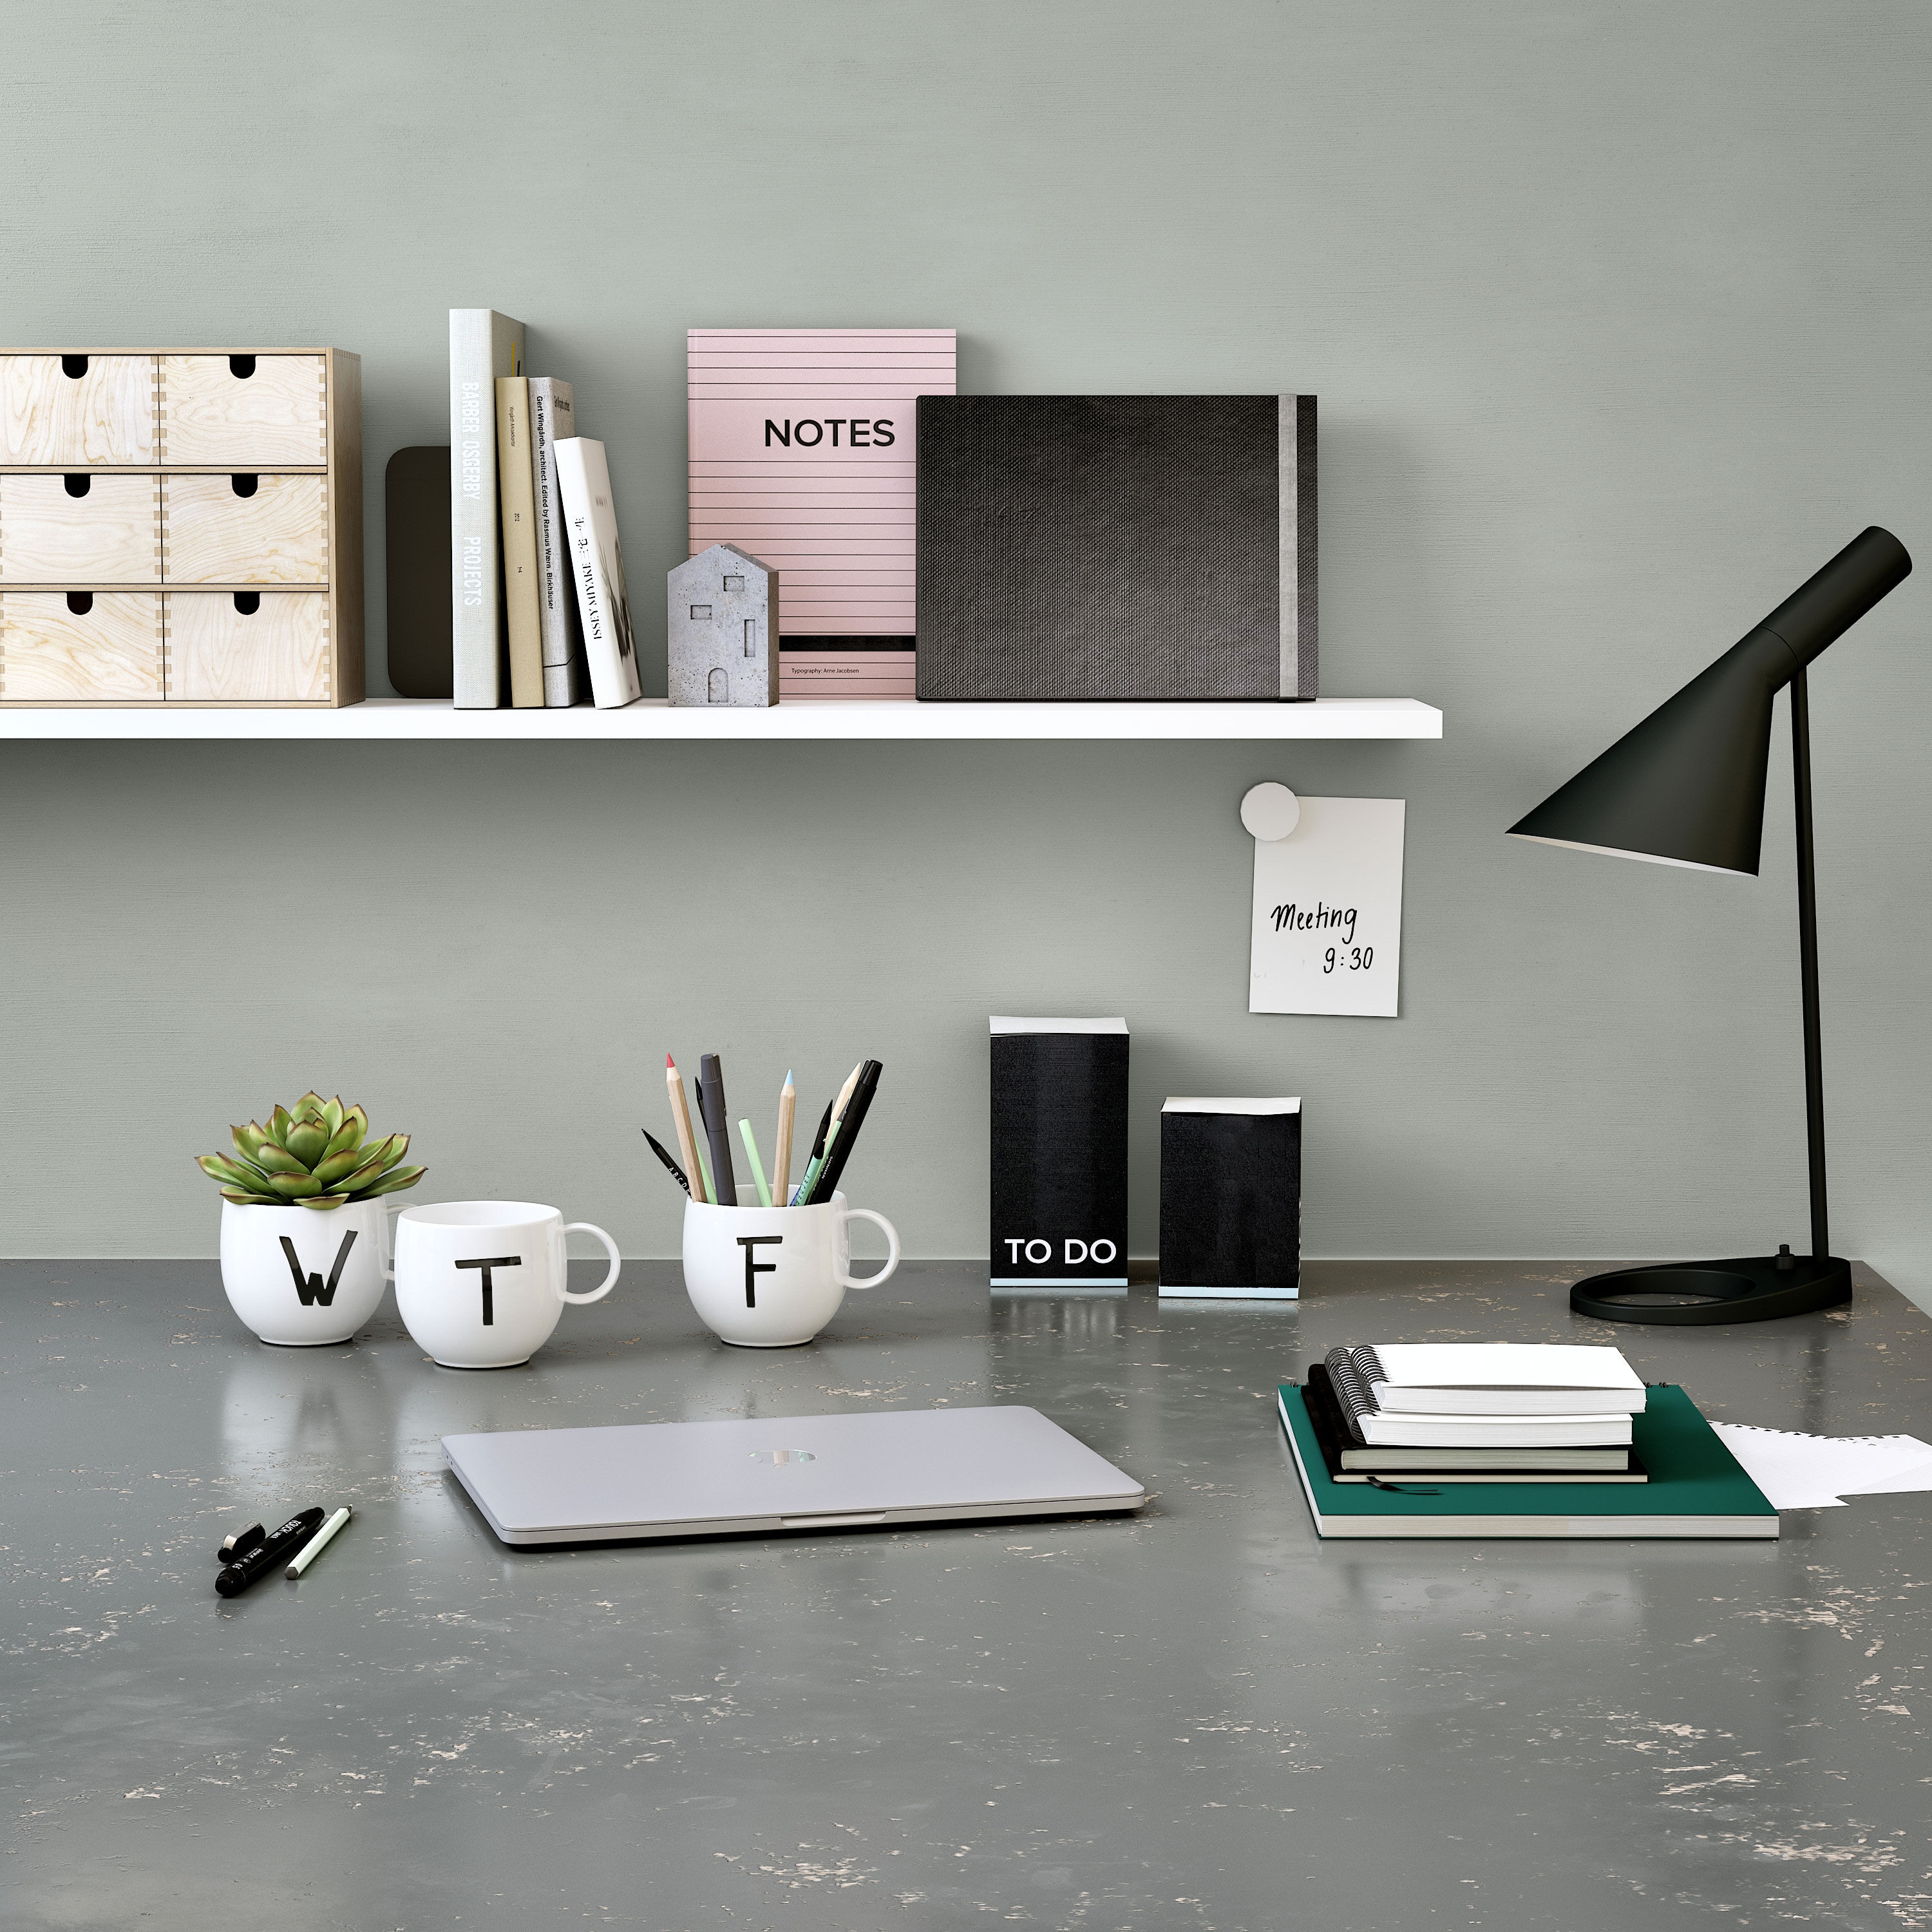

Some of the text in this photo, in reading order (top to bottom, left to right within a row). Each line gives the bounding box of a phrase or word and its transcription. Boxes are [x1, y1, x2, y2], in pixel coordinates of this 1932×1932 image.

[764, 419, 895, 447] NOTES
[461, 383, 482, 606] BARBER OSGERBY PROJECTS
[542, 509, 549, 518] by
[582, 562, 602, 639] ISSEY MIYAKE
[1270, 902, 1358, 944] Meeting
[1323, 947, 1373, 973] 9:30
[821, 1156, 833, 1179] SHINHAN
[279, 1230, 358, 1307] W
[736, 1235, 783, 1308] F
[1004, 1238, 1117, 1264] TO DO
[455, 1255, 522, 1326] T
